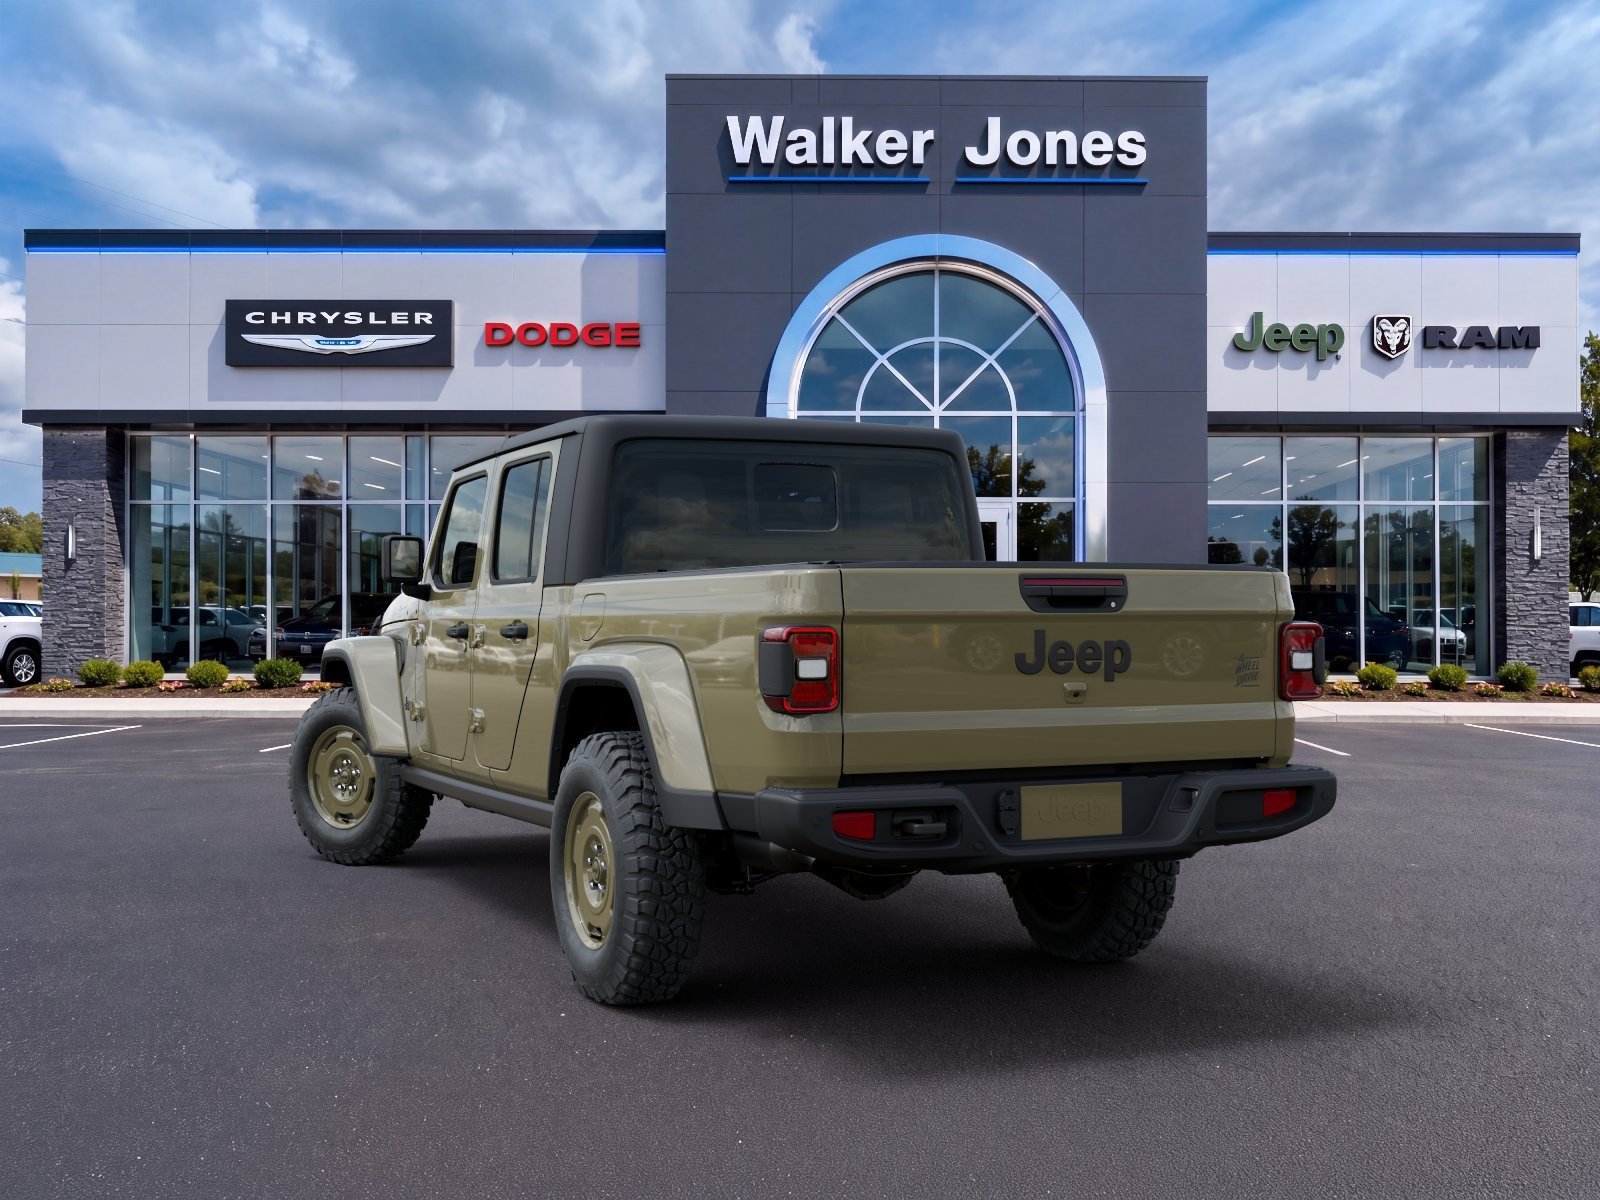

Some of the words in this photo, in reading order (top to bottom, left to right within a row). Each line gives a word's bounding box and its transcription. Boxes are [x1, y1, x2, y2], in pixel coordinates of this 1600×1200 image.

[726, 115, 935, 165] Walker
[964, 116, 1147, 167] Jones
[245, 311, 434, 325] CHRYSLER
[485, 322, 641, 347] DODGE
[1234, 311, 1345, 361] Jeep
[1424, 325, 1541, 348] RAM
[1015, 629, 1131, 682] Jeep
[1038, 793, 1105, 826] Jeep
